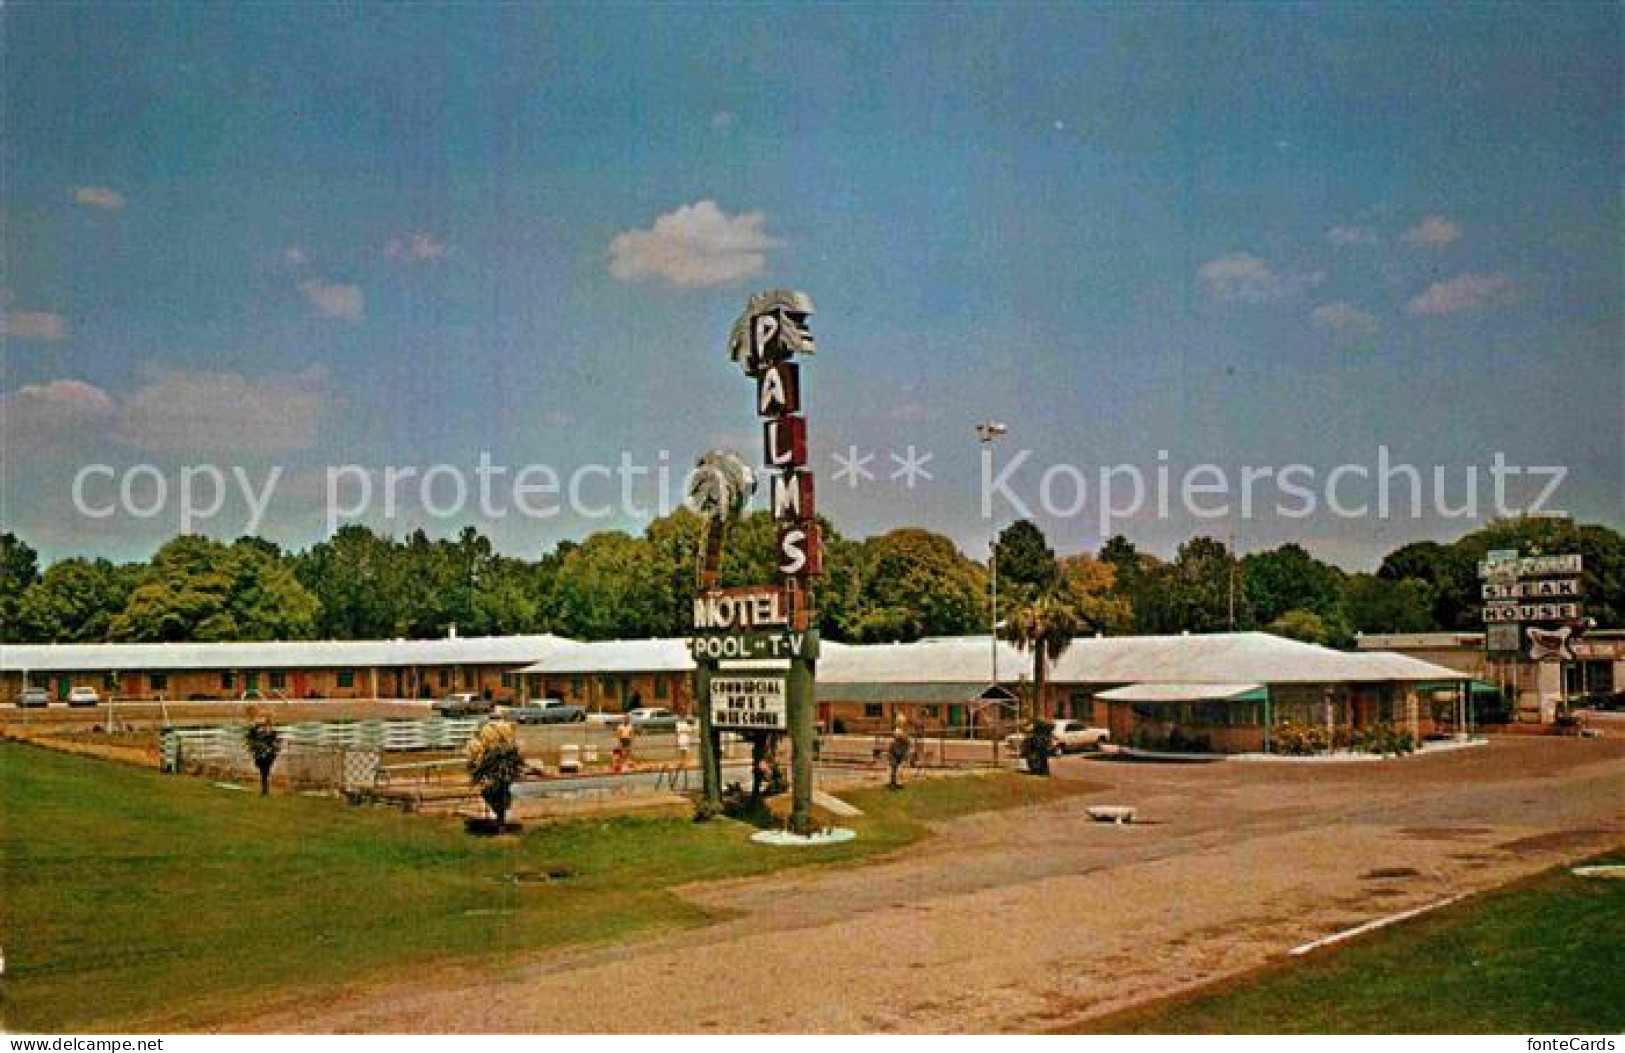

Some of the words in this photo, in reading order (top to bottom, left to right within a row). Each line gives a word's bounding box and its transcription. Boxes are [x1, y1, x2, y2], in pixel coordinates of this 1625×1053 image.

[756, 314, 807, 575] PALMS
[693, 592, 788, 628] MOTEL
[1481, 603, 1575, 620] HOUSE
[695, 634, 753, 658] POOL
